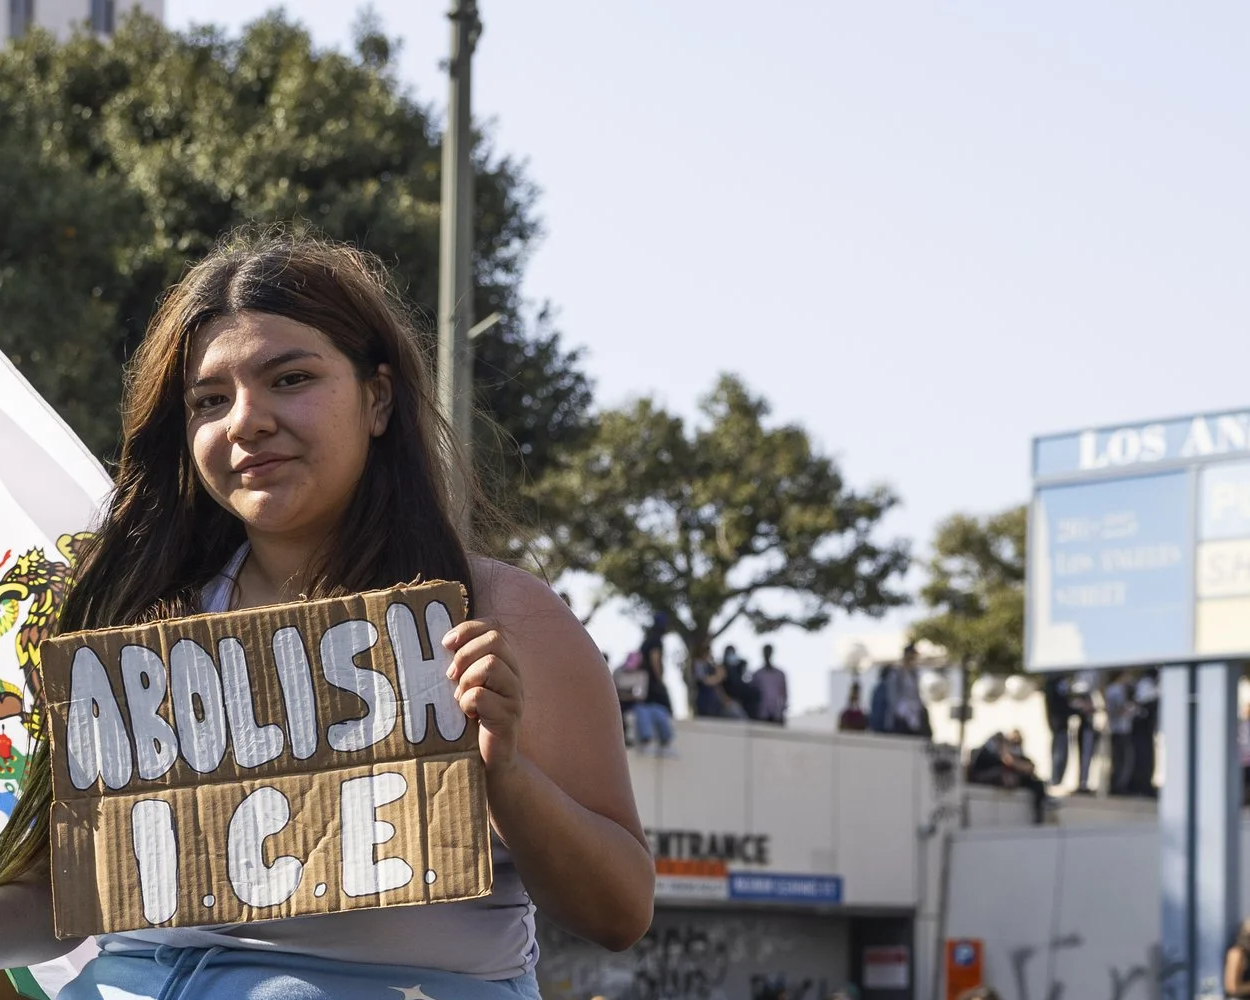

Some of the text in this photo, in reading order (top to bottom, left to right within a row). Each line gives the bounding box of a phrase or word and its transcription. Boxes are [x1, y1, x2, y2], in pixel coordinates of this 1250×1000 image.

[1079, 426, 1166, 470] LOS
[67, 600, 468, 791] ABOLISH
[131, 771, 438, 926] I.C.E.
